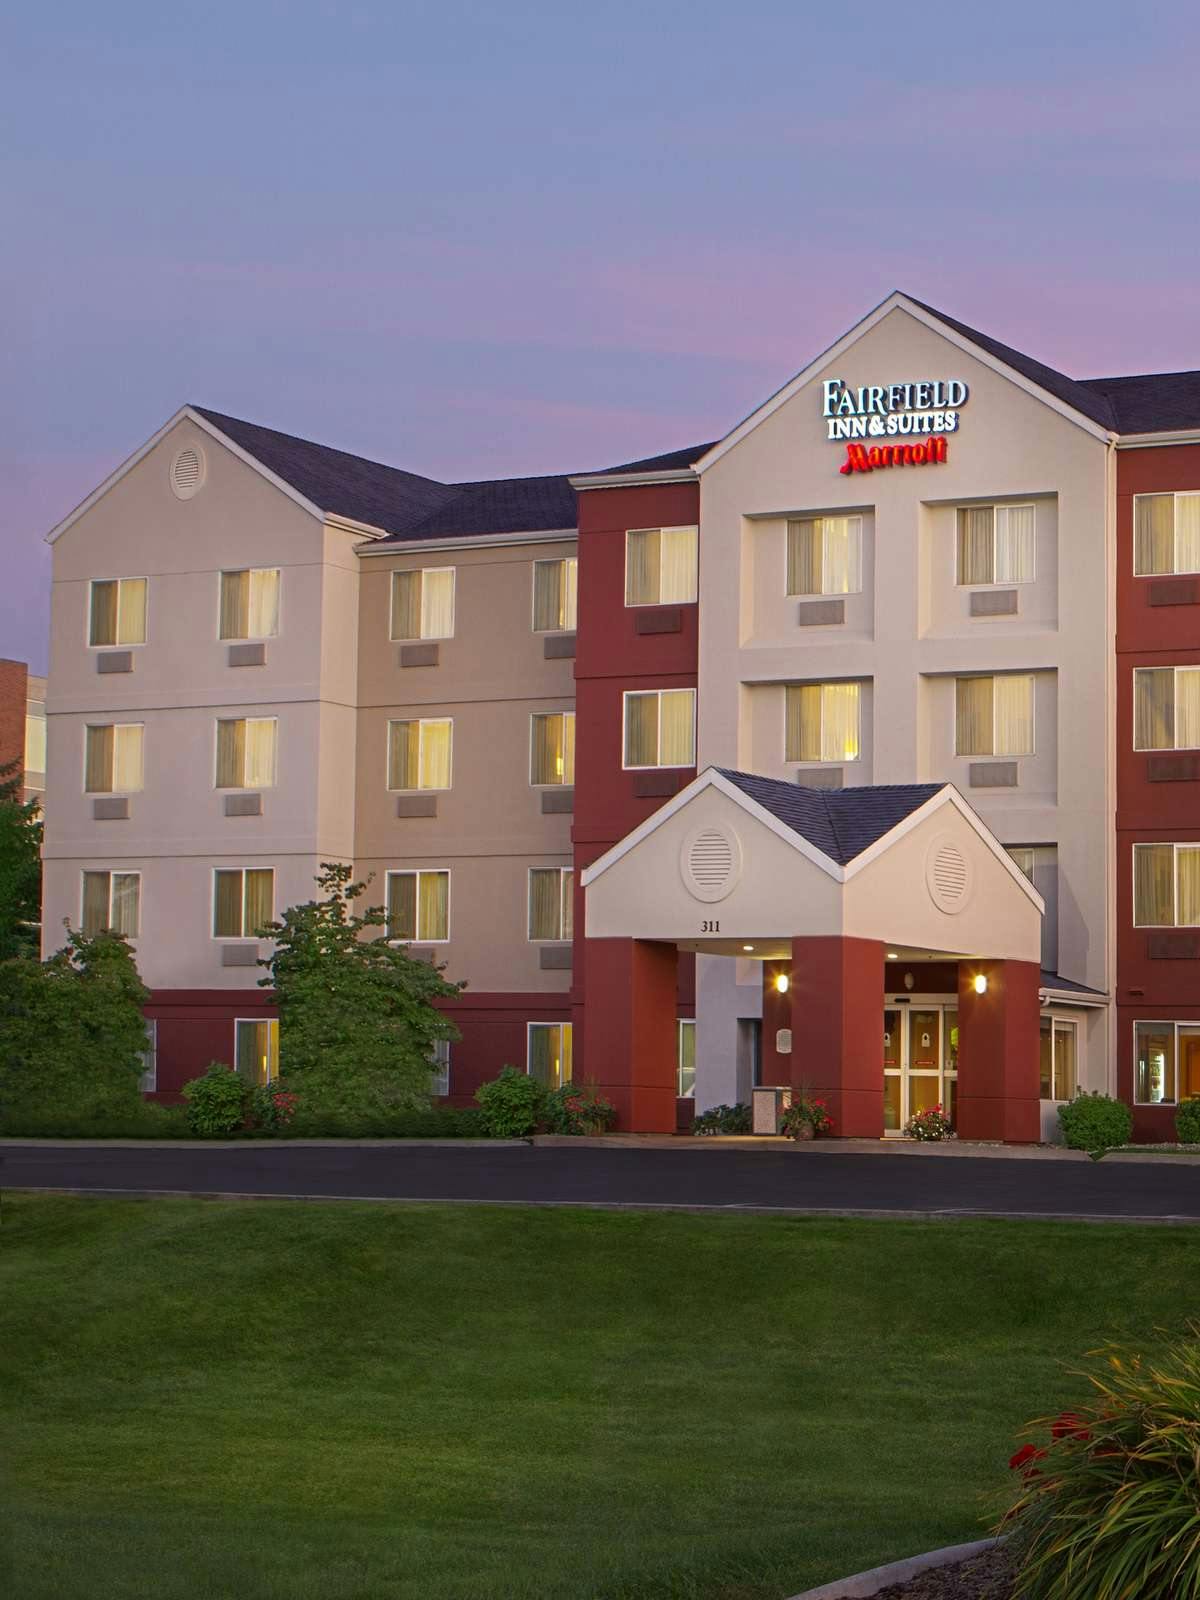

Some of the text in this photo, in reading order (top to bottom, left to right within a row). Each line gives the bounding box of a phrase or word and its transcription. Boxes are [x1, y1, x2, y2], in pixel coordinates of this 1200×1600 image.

[822, 379, 969, 416] FAIRFIELD
[827, 416, 868, 440] INN
[886, 411, 958, 435] SUITES
[839, 435, 948, 474] Marriott
[700, 920, 720, 932] 311
